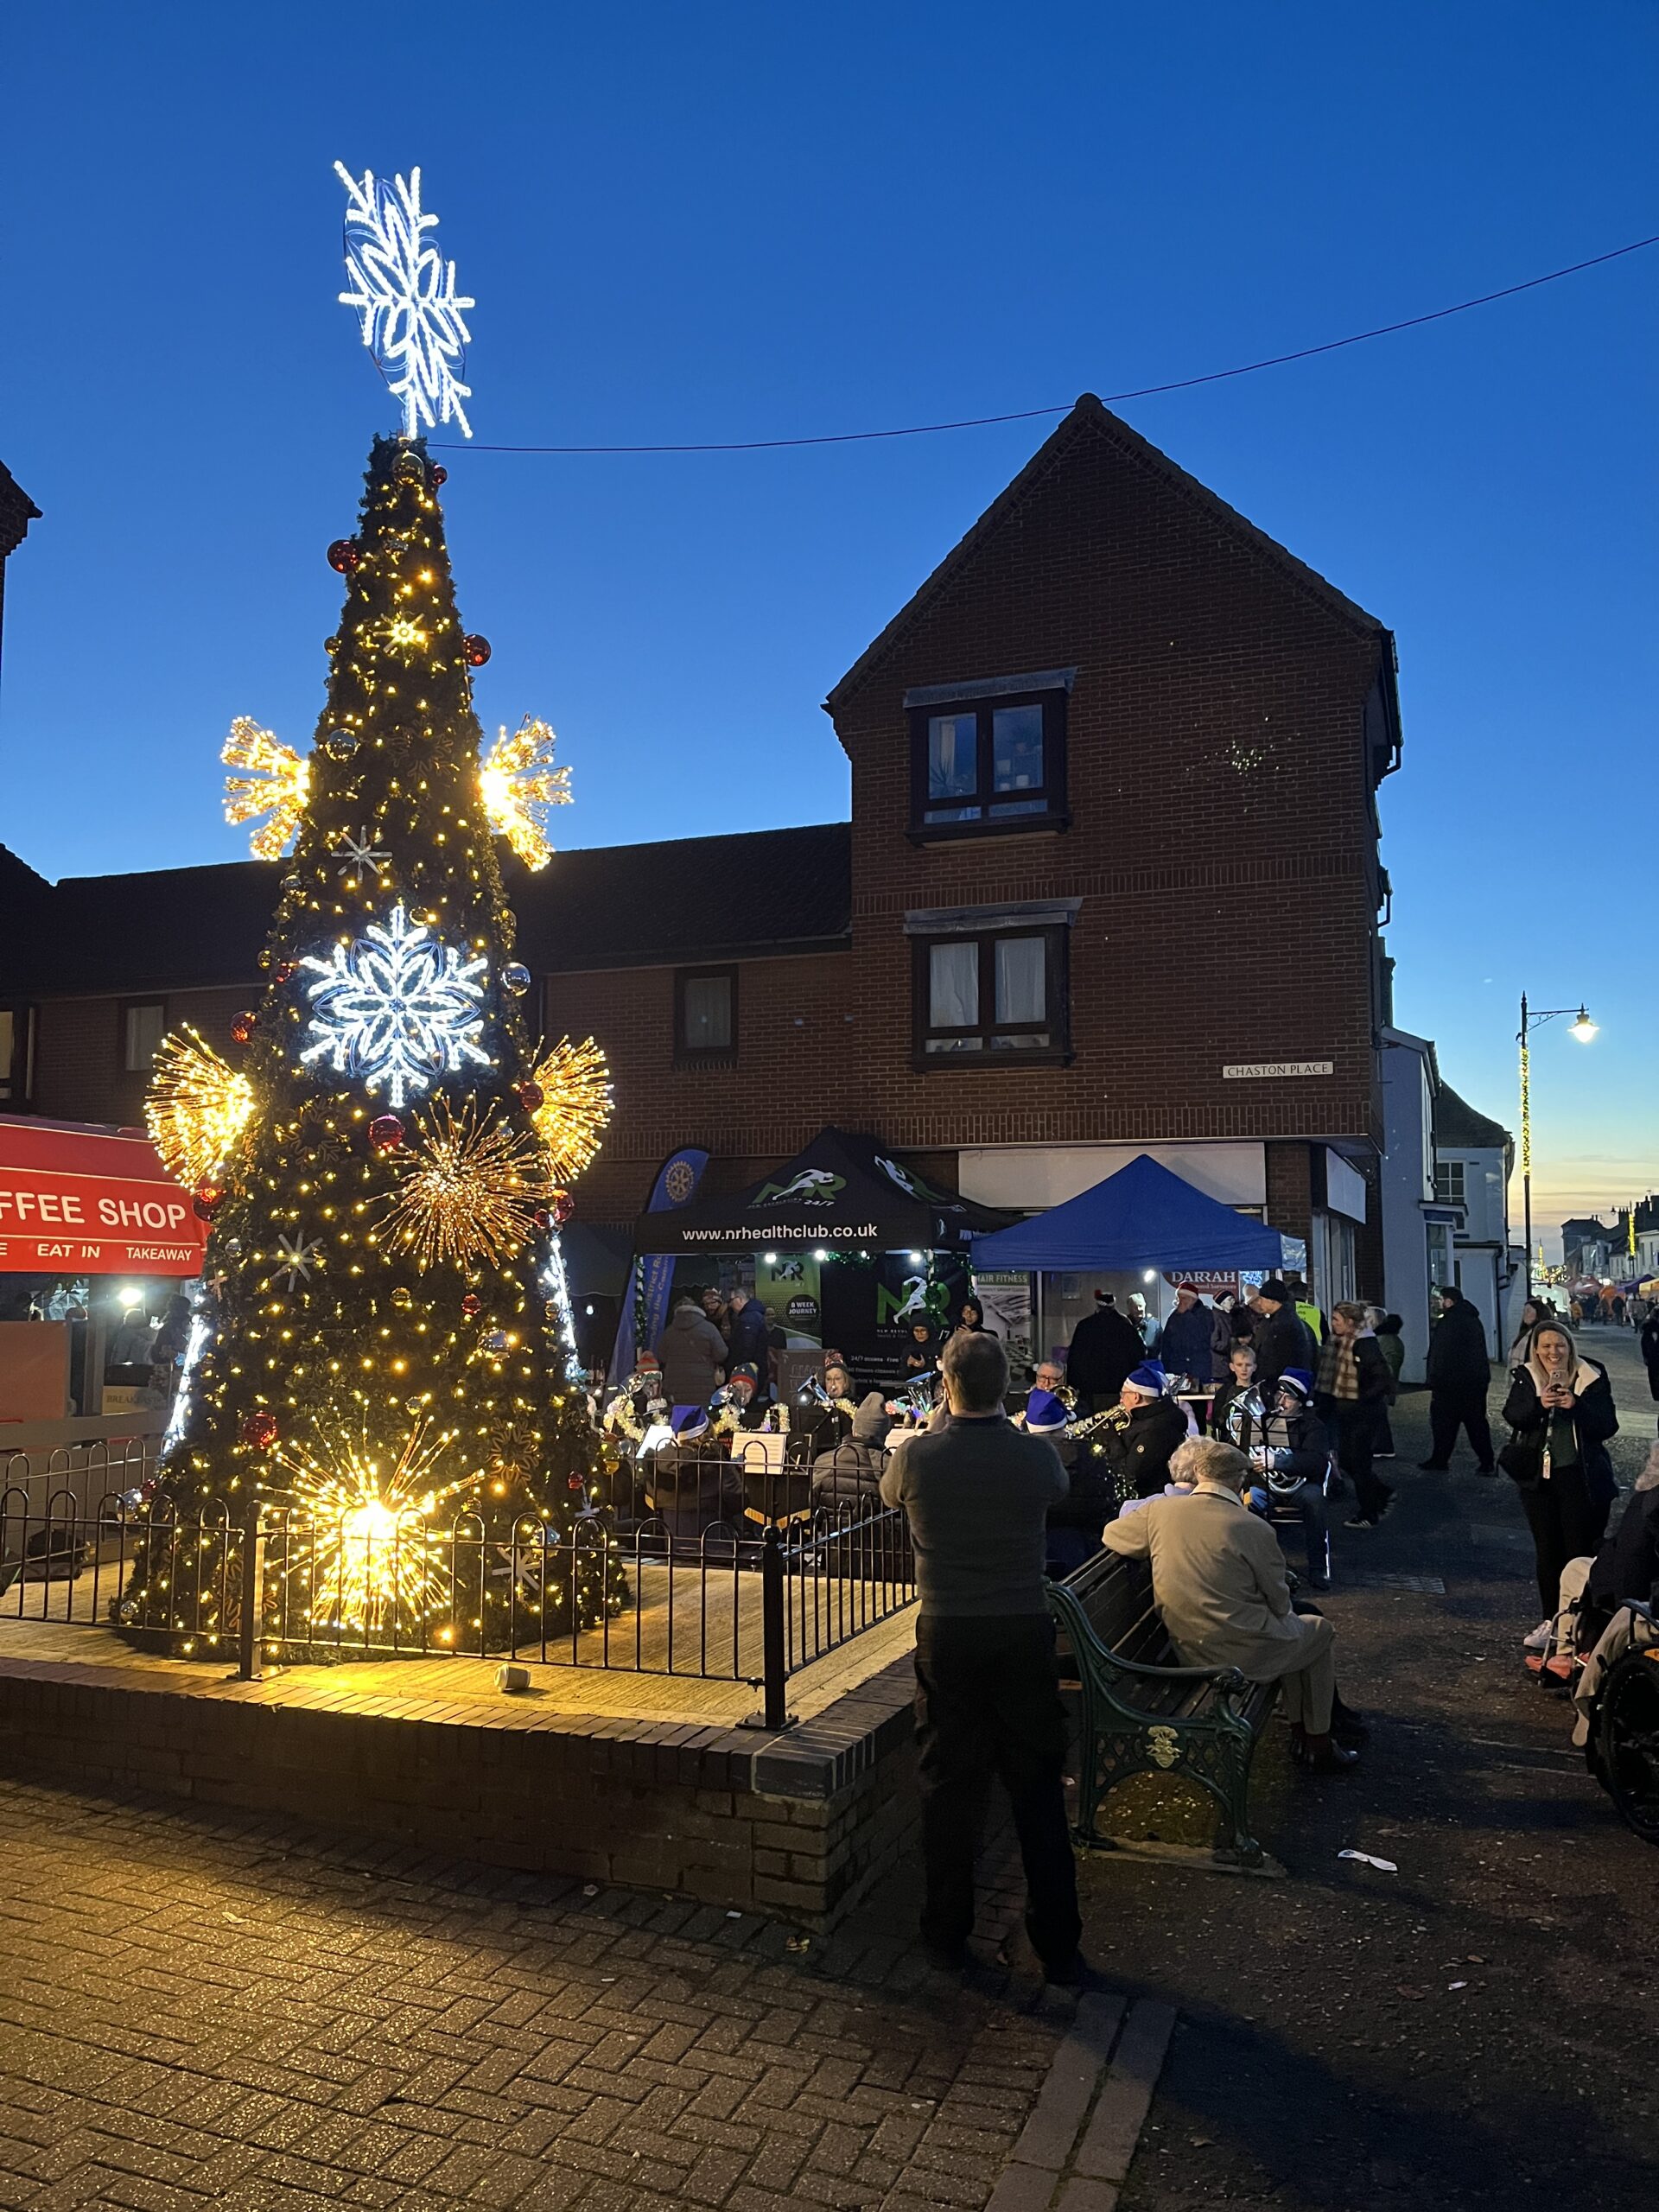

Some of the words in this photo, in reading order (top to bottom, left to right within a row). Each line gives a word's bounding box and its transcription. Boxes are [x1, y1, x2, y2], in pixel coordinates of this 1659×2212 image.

[1228, 1065, 1286, 1077] CHASTON
[1290, 1064, 1328, 1074] PLACE
[803, 1198, 836, 1207] 24/7
[98, 1198, 186, 1230] SHOP
[682, 1223, 878, 1241] www.nrhealthclub.co.uk
[37, 1243, 74, 1257] EAT
[81, 1245, 101, 1258] IN
[126, 1247, 192, 1261] TAKEAWAY
[996, 1274, 1027, 1283] FITNESS
[1172, 1271, 1236, 1282] DARRAH
